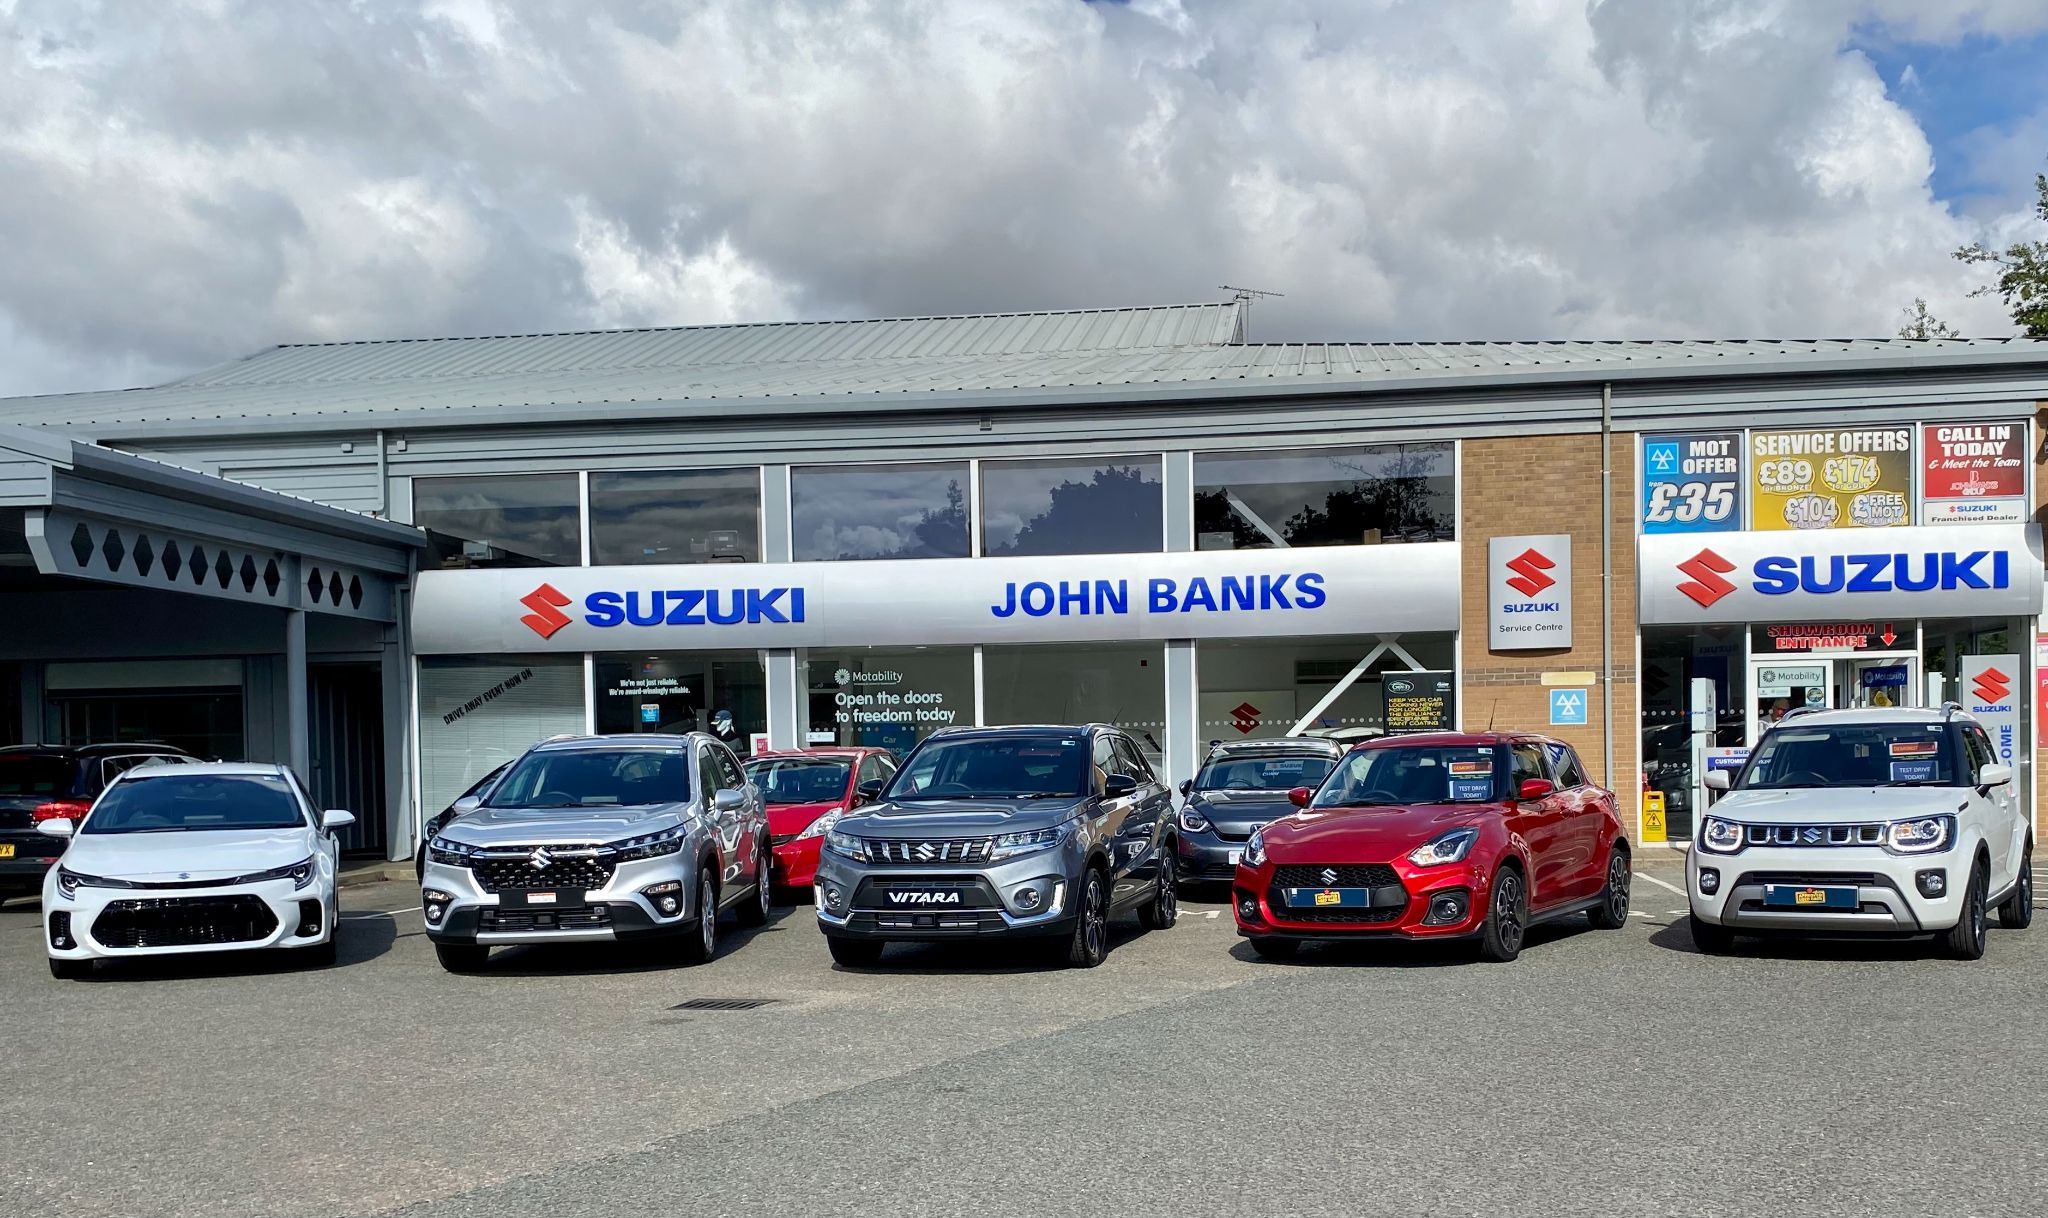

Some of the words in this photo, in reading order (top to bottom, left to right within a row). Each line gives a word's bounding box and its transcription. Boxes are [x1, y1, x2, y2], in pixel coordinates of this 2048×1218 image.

[1937, 427, 1984, 441] CALL
[1989, 426, 2010, 440] IN
[1689, 440, 1730, 456] MOT
[1754, 433, 1835, 455] SERVICE
[1839, 430, 1909, 452] OFFERS
[1941, 442, 2006, 457] TODAY
[1682, 457, 1737, 474] OFFER
[1824, 456, 1877, 483] £174
[1928, 459, 1939, 469] &
[1941, 459, 1970, 469] Meet
[1971, 458, 1990, 468] the
[1993, 457, 2020, 467] Team
[1759, 460, 1812, 485] £89
[1645, 481, 1736, 522] £35
[1870, 495, 1902, 505] FREE
[1785, 496, 1837, 522] £104
[1871, 506, 1901, 518] MOT
[1957, 505, 1997, 513] SUZUKI
[1753, 551, 2009, 594] SUZUKI
[991, 580, 1128, 617] JOHN
[1148, 573, 1326, 613] BANKS
[585, 588, 804, 627] SUZUKI
[1503, 602, 1559, 613] SUZUKI
[1767, 623, 1875, 637] SHOWROOM
[1776, 635, 1867, 649] ENTRANCE
[646, 679, 656, 687] just
[657, 678, 678, 686] reliable.
[853, 671, 903, 683] Motability
[1778, 672, 1821, 681] Motability
[443, 706, 464, 725] DRIVE
[464, 695, 484, 714] AWAY
[482, 684, 505, 702] EVENT
[504, 673, 522, 689] NOW
[520, 668, 533, 680] ON
[835, 692, 873, 708] Open
[876, 691, 900, 705] the
[904, 690, 943, 704] doors
[835, 710, 849, 722] to
[853, 708, 912, 722] freedom
[915, 707, 955, 723] today
[888, 892, 960, 903] VITARA
